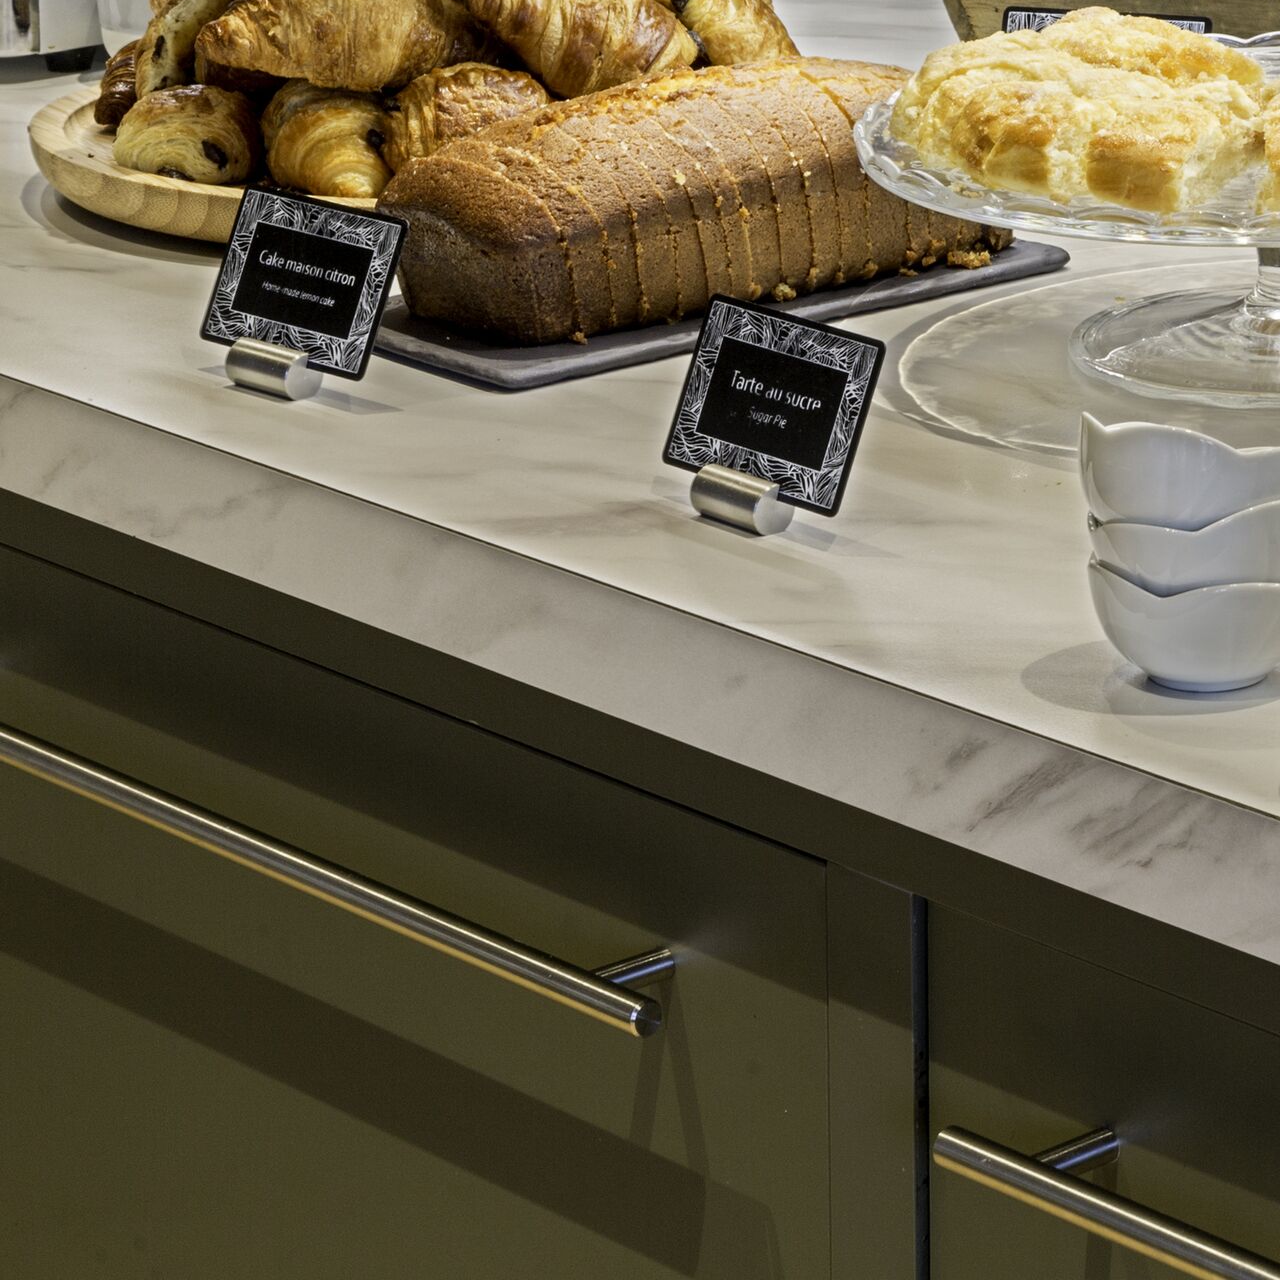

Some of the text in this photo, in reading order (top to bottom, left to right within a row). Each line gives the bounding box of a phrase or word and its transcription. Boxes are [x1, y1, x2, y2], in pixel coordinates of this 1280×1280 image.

[259, 249, 356, 287] Cake maison citron
[300, 290, 320, 303] lemon
[319, 296, 335, 307] cake
[731, 370, 764, 395] Tarte
[785, 392, 821, 410] sucre
[773, 414, 788, 429] Pie
